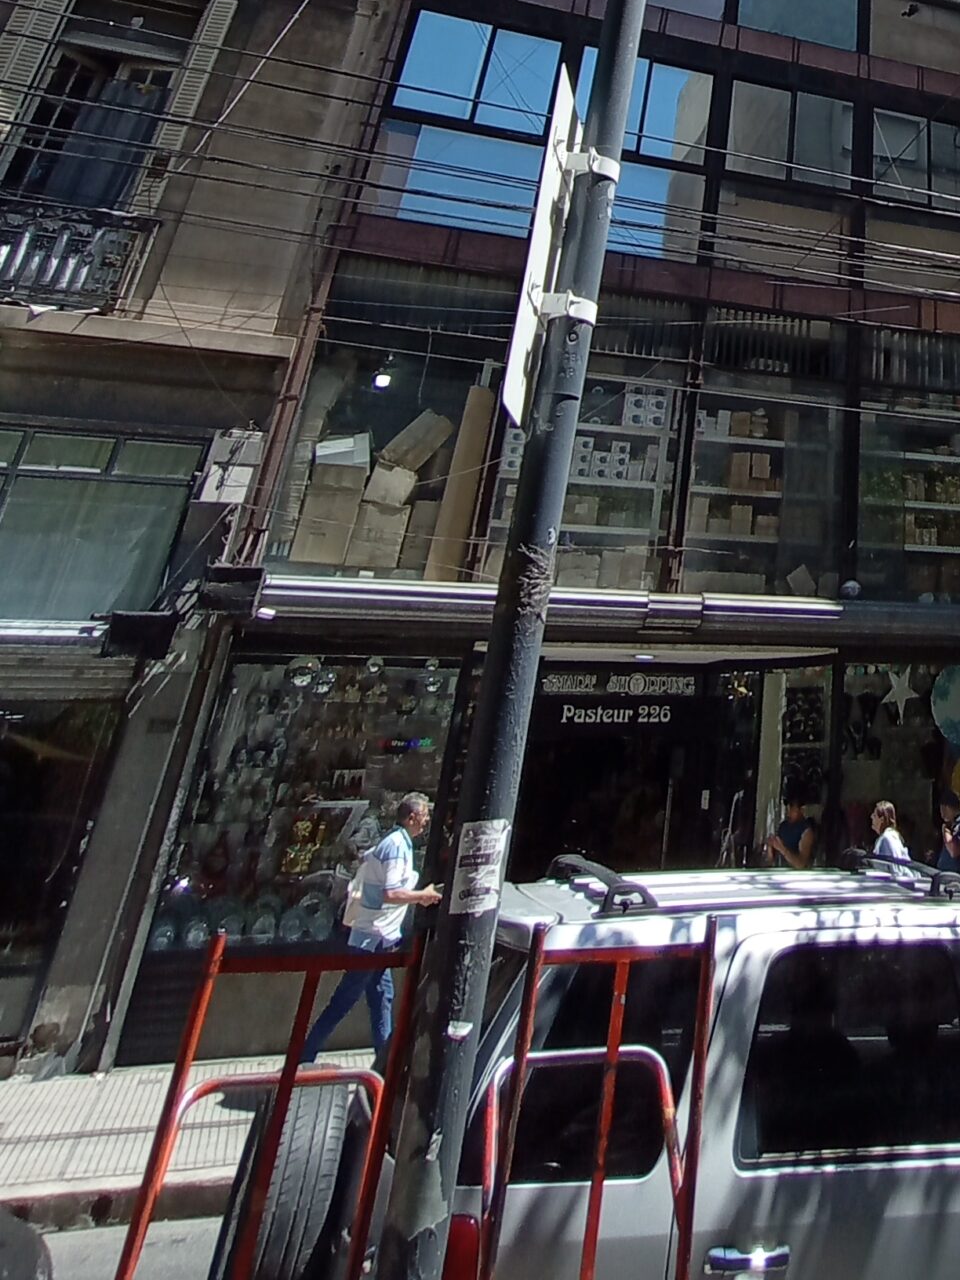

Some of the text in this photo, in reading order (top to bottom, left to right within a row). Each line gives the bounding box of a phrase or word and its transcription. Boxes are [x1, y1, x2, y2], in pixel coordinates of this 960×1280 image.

[542, 672, 695, 695] SMART SHOPPING
[561, 704, 671, 723] Pasteur 226
